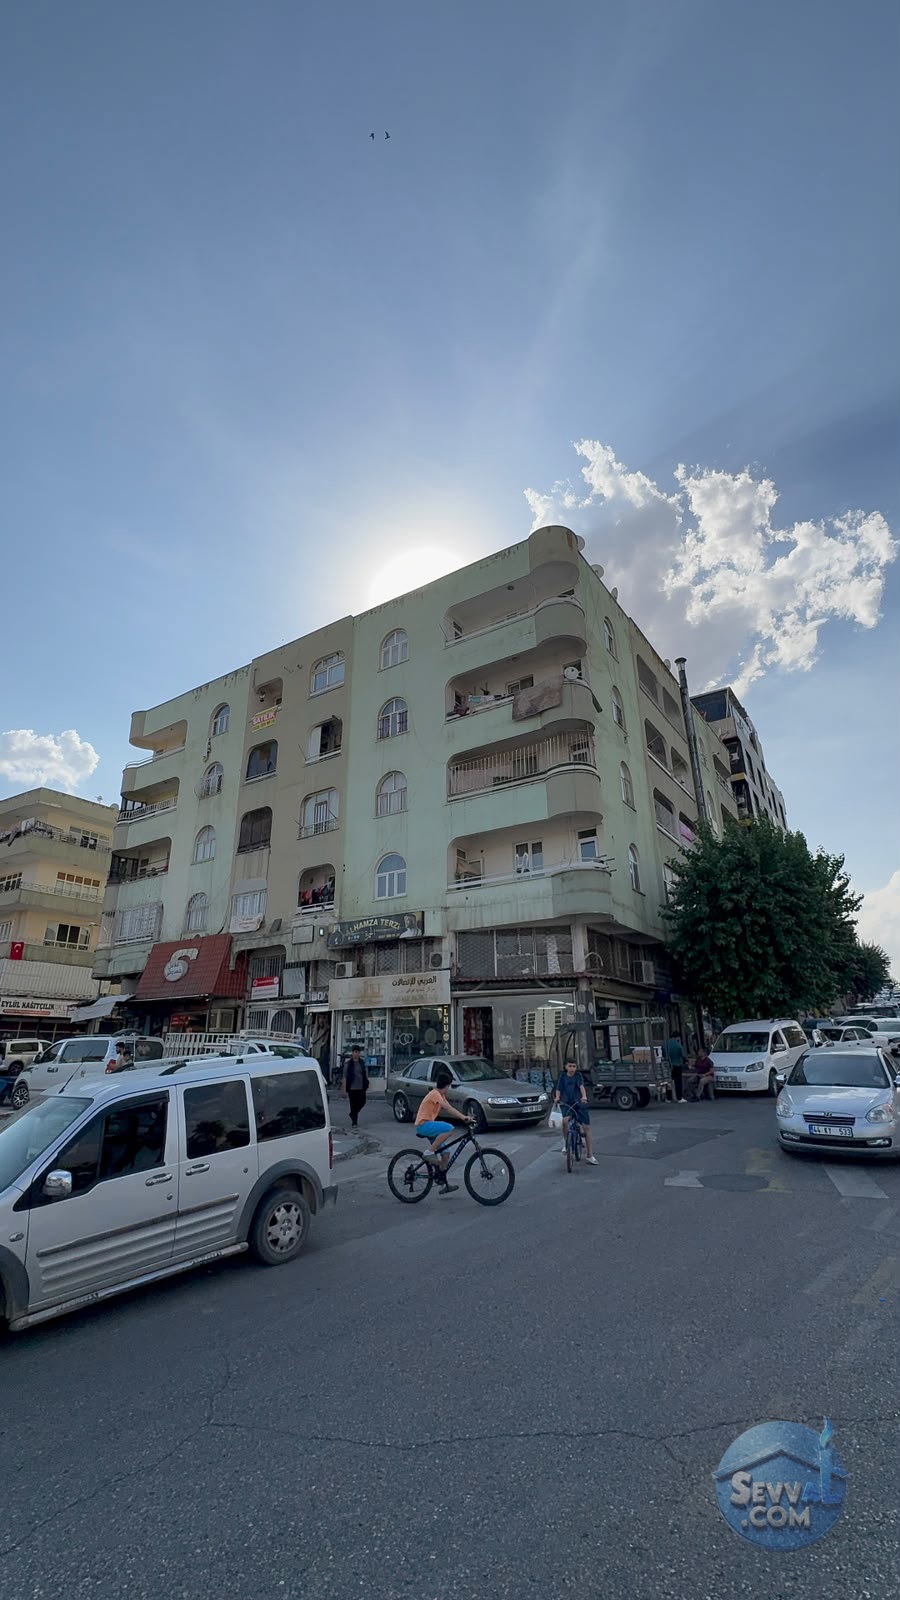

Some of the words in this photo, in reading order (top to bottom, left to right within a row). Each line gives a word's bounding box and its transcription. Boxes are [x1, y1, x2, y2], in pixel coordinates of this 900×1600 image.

[252, 710, 277, 726] SATILIK
[345, 918, 378, 937] ALHAMZA
[1, 1000, 20, 1008] EYLÜL
[839, 1128, 851, 1136] 533
